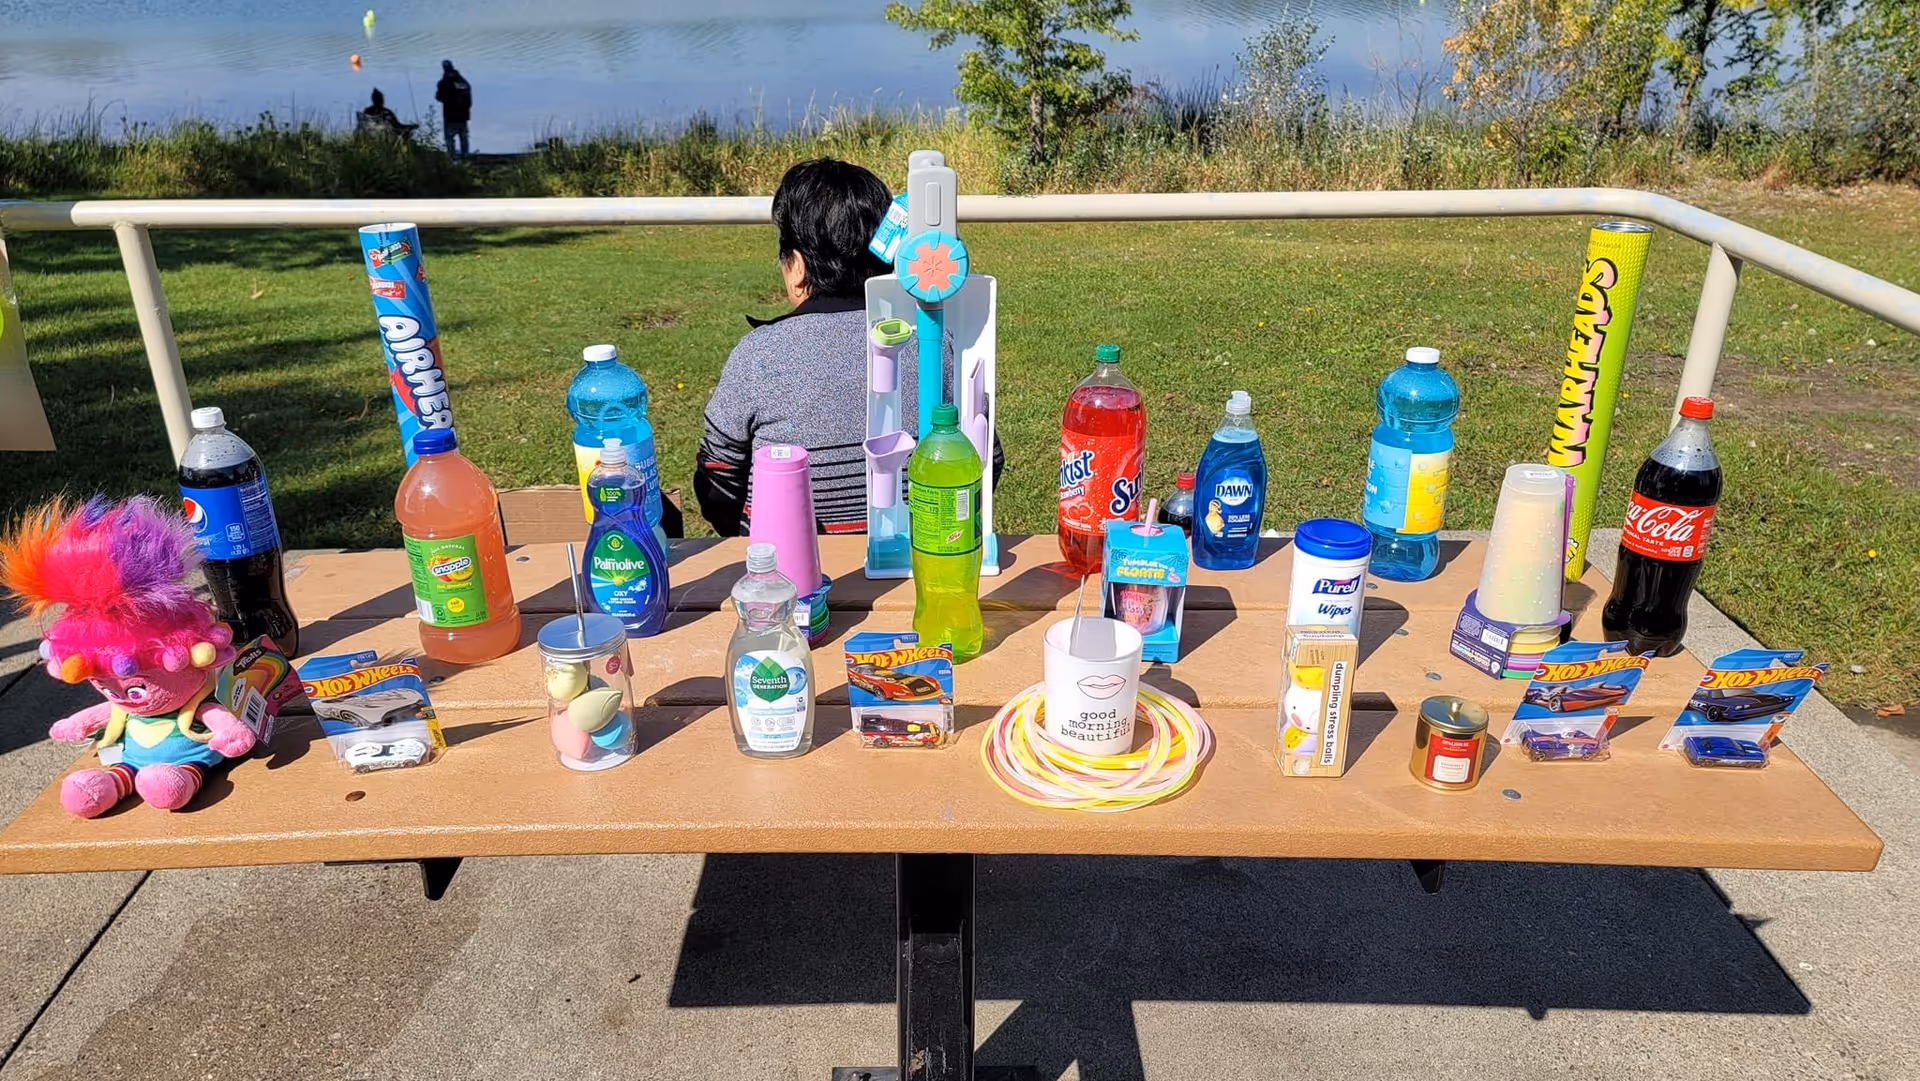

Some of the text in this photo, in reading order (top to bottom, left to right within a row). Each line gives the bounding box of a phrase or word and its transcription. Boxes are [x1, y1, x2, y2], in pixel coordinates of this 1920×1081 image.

[379, 315, 453, 429] AIRHEA
[1215, 485, 1253, 497] DAWN
[593, 556, 645, 571] Palmolive
[1318, 603, 1353, 619] Wipes
[752, 675, 787, 684] Seventh
[1080, 709, 1117, 722] good
[1324, 662, 1344, 764] dumpling stress balls
